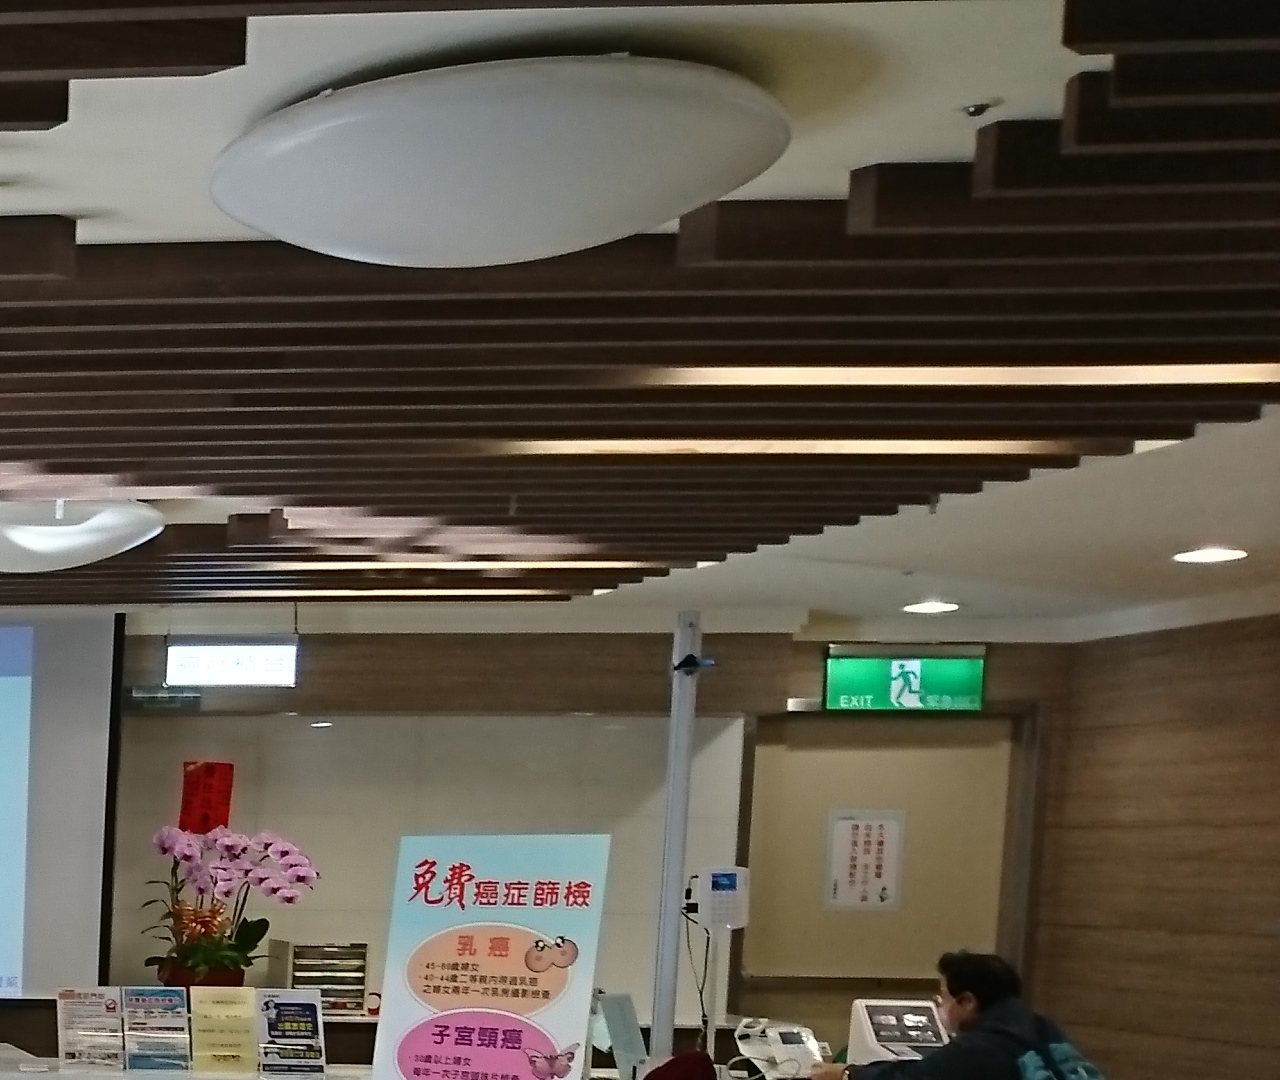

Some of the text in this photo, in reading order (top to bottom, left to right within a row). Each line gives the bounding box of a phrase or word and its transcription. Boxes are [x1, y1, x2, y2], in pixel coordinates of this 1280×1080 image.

[840, 695, 874, 708] EXIT
[457, 935, 511, 957] 乳癌
[431, 1024, 523, 1050] 子宮頸癌
